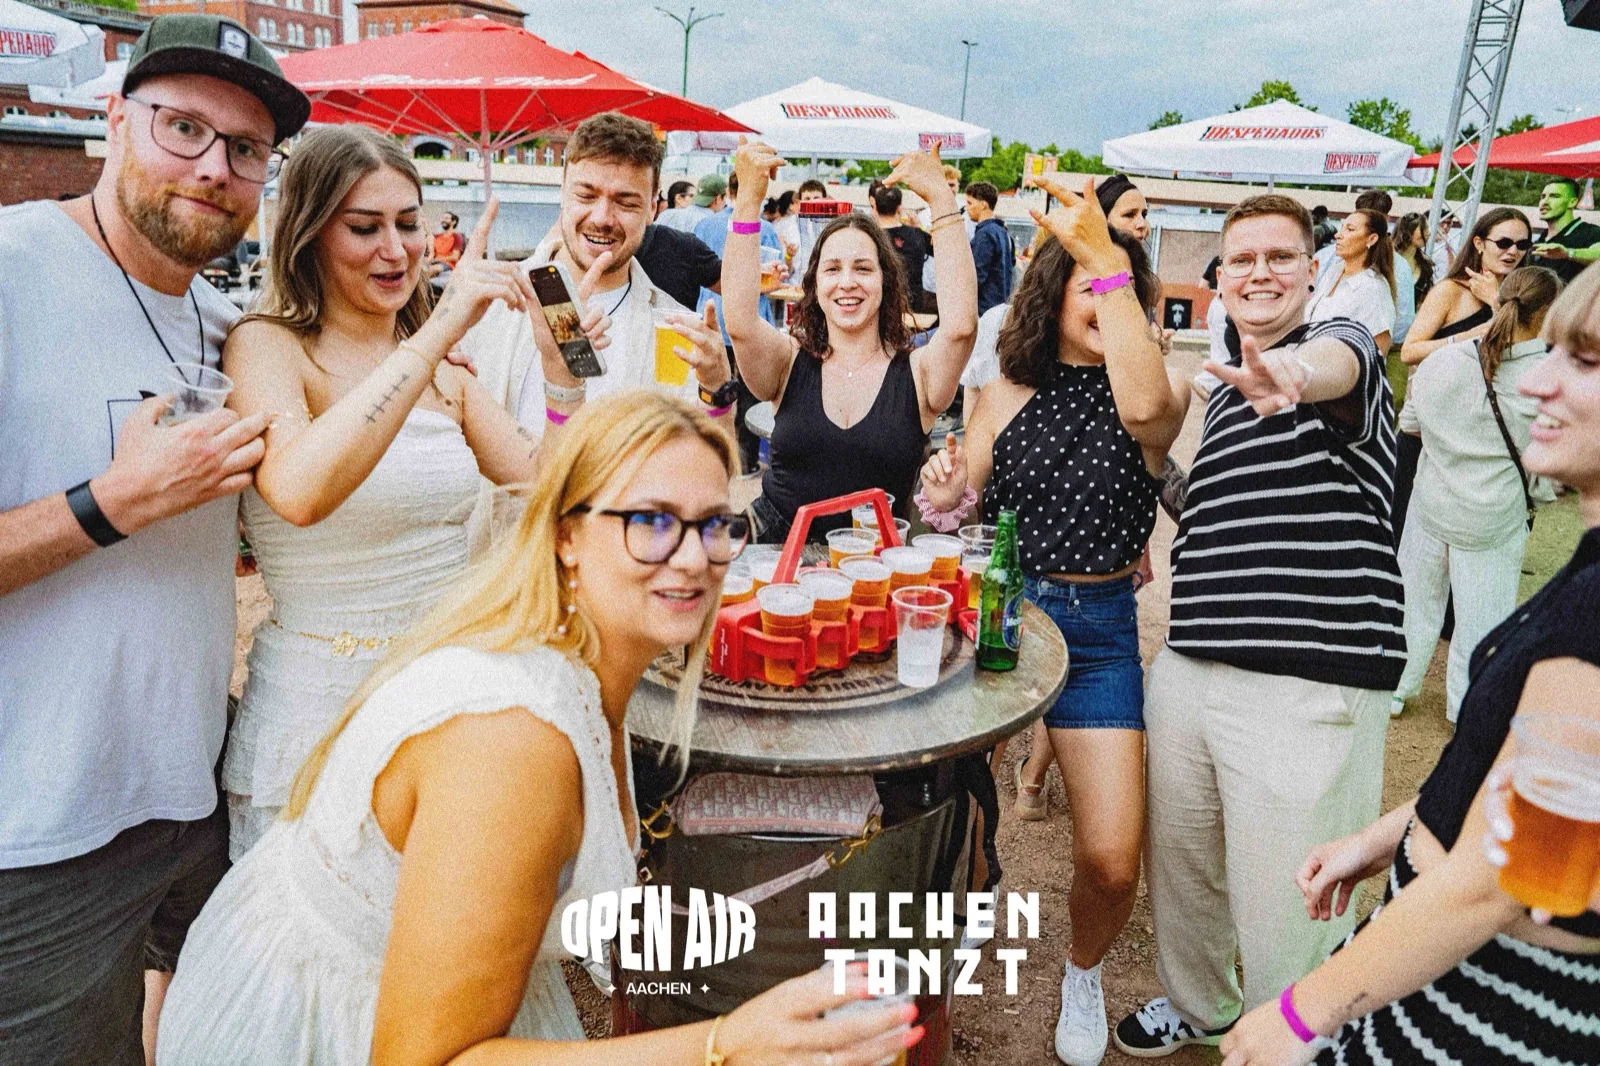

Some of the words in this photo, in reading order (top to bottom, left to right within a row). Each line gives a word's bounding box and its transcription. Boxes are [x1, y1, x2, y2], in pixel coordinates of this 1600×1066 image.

[786, 103, 897, 119] DESPERADOS
[1204, 125, 1324, 140] DESPERADOS
[1325, 153, 1377, 171] DESPERADOS
